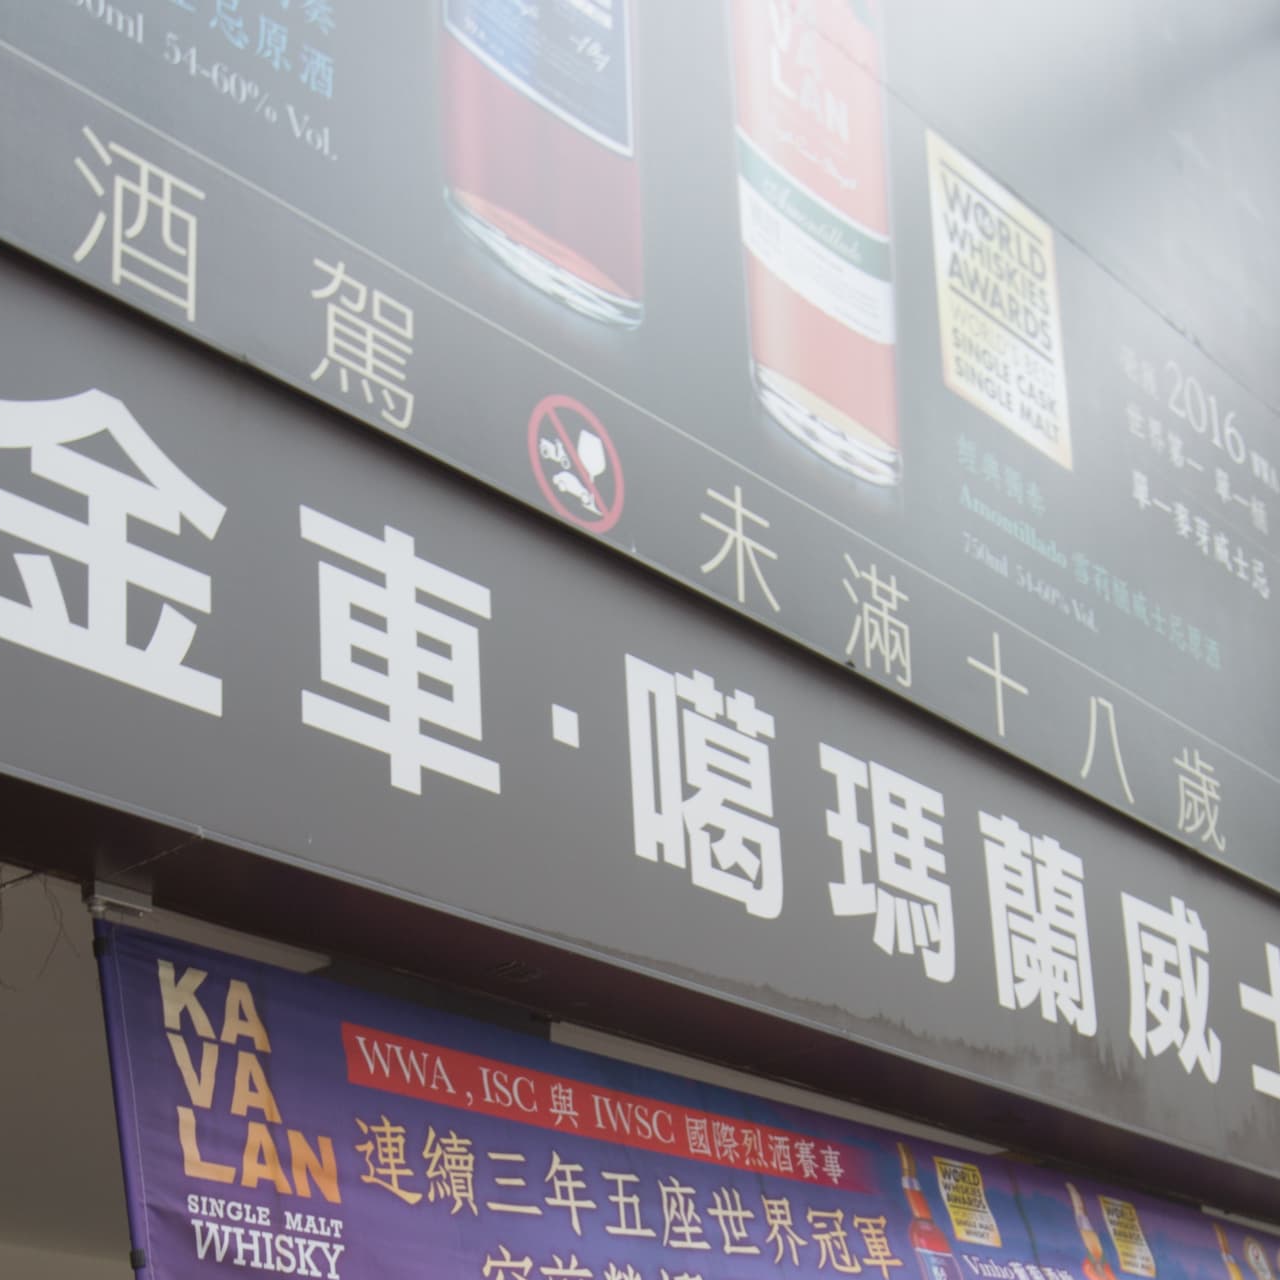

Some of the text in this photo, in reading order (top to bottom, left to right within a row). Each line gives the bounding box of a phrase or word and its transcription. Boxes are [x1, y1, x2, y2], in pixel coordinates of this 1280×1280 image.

[164, 32, 277, 123] 54-60%
[285, 103, 338, 160] Vol.
[175, 0, 335, 100] 忌原酒
[941, 172, 1047, 282] WORLD
[942, 211, 1051, 316] WHISKIES
[947, 252, 1053, 352] AWARDS
[1166, 359, 1247, 465] 2016
[548, 1081, 580, 1129] 與
[591, 1094, 676, 1146] IWSC
[685, 1113, 846, 1186] 國際烈酒賽事
[940, 1166, 980, 1187] WORLD
[187, 1193, 344, 1238] SINGLE MALT
[191, 1219, 345, 1280] WHISKY
[354, 1114, 904, 1280] 連續三年五座世界冠軍
